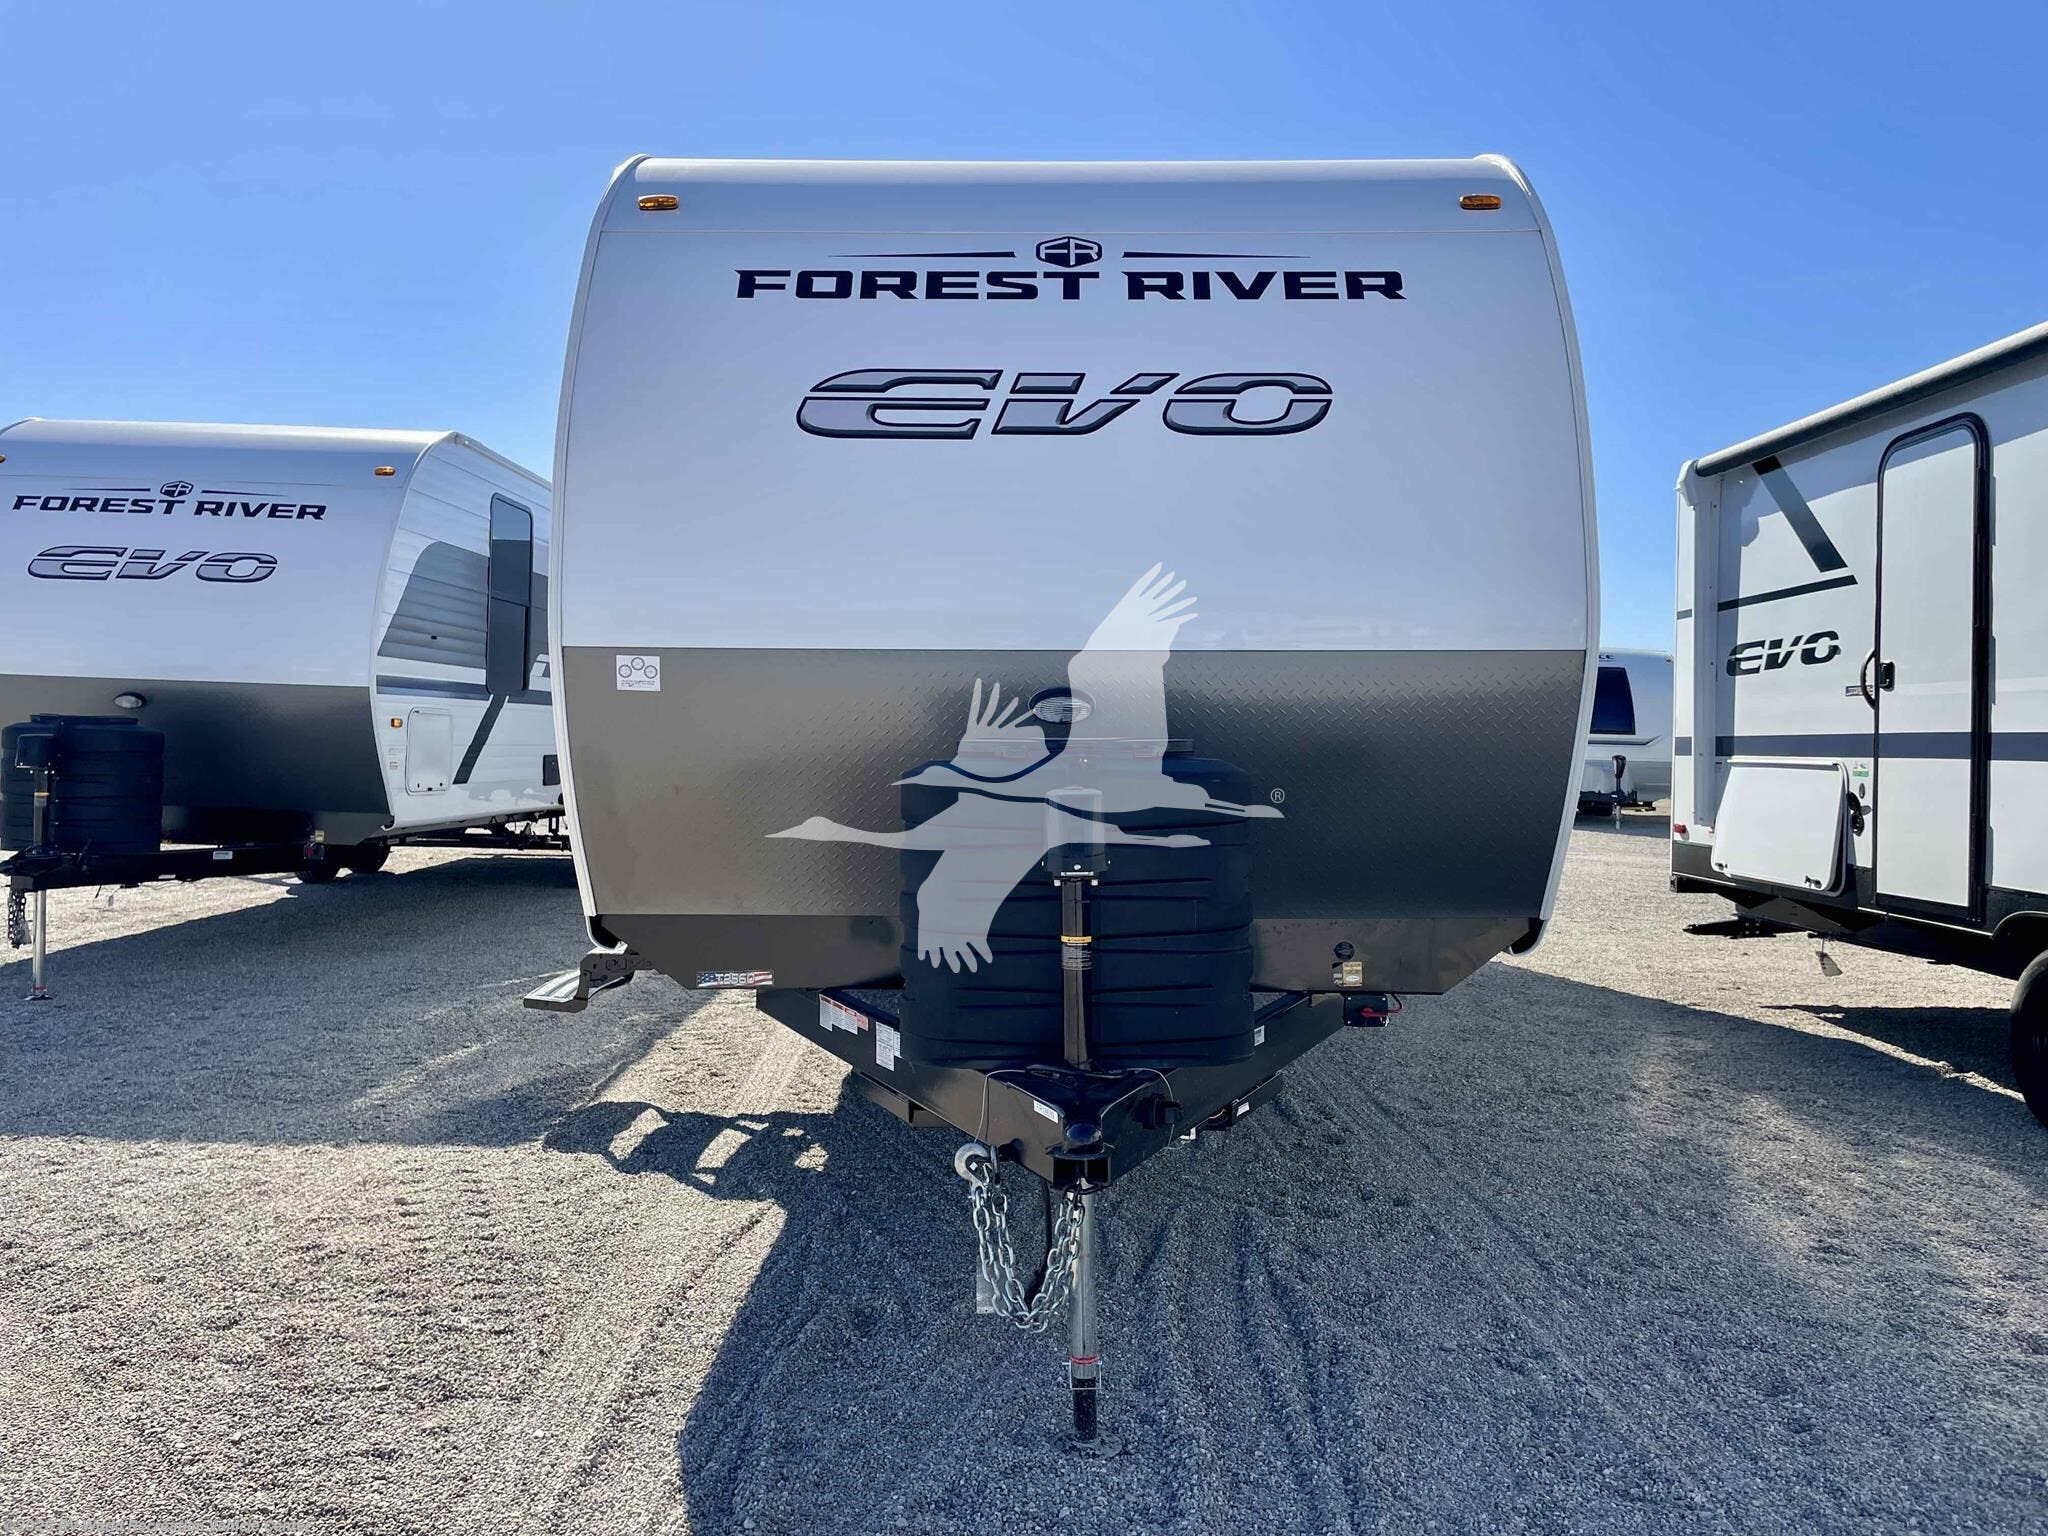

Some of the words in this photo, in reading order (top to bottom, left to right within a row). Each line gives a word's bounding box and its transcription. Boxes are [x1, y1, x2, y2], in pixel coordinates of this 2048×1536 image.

[1037, 239, 1101, 265] FR
[735, 269, 1101, 300] FOREST
[1122, 270, 1407, 300] RIVER
[795, 368, 1333, 440] EVO
[12, 495, 186, 515] FOREST
[194, 501, 327, 520] RIVER
[27, 545, 278, 583] EVO
[1726, 630, 1842, 677] EVO
